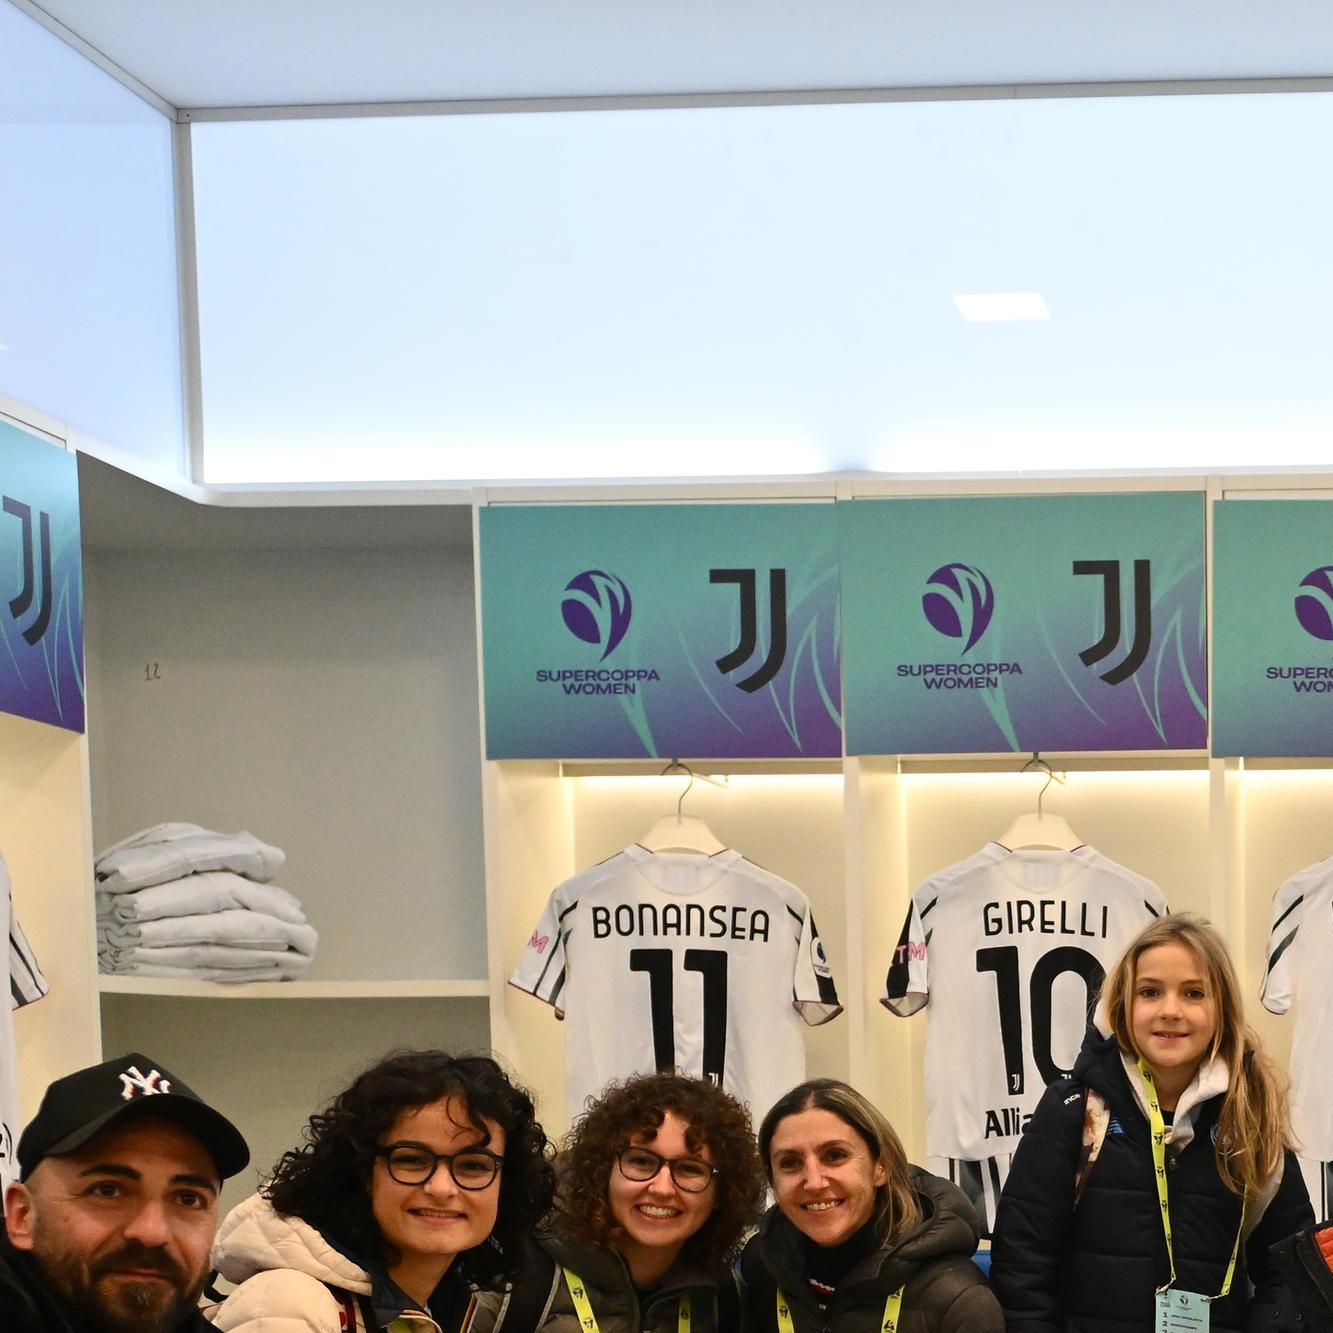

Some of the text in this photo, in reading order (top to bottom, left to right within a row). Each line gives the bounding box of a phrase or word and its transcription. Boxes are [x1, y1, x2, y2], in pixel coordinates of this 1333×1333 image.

[536, 669, 660, 682] SUPERCOPPA
[897, 662, 1023, 677] SUPERCOPPA
[562, 683, 636, 695] WOMEN
[923, 676, 998, 690] WOMEN
[592, 903, 770, 942] BONANSEA
[983, 900, 1107, 938] GIRELLI
[630, 948, 728, 1090] 11
[976, 945, 1107, 1095] 10
